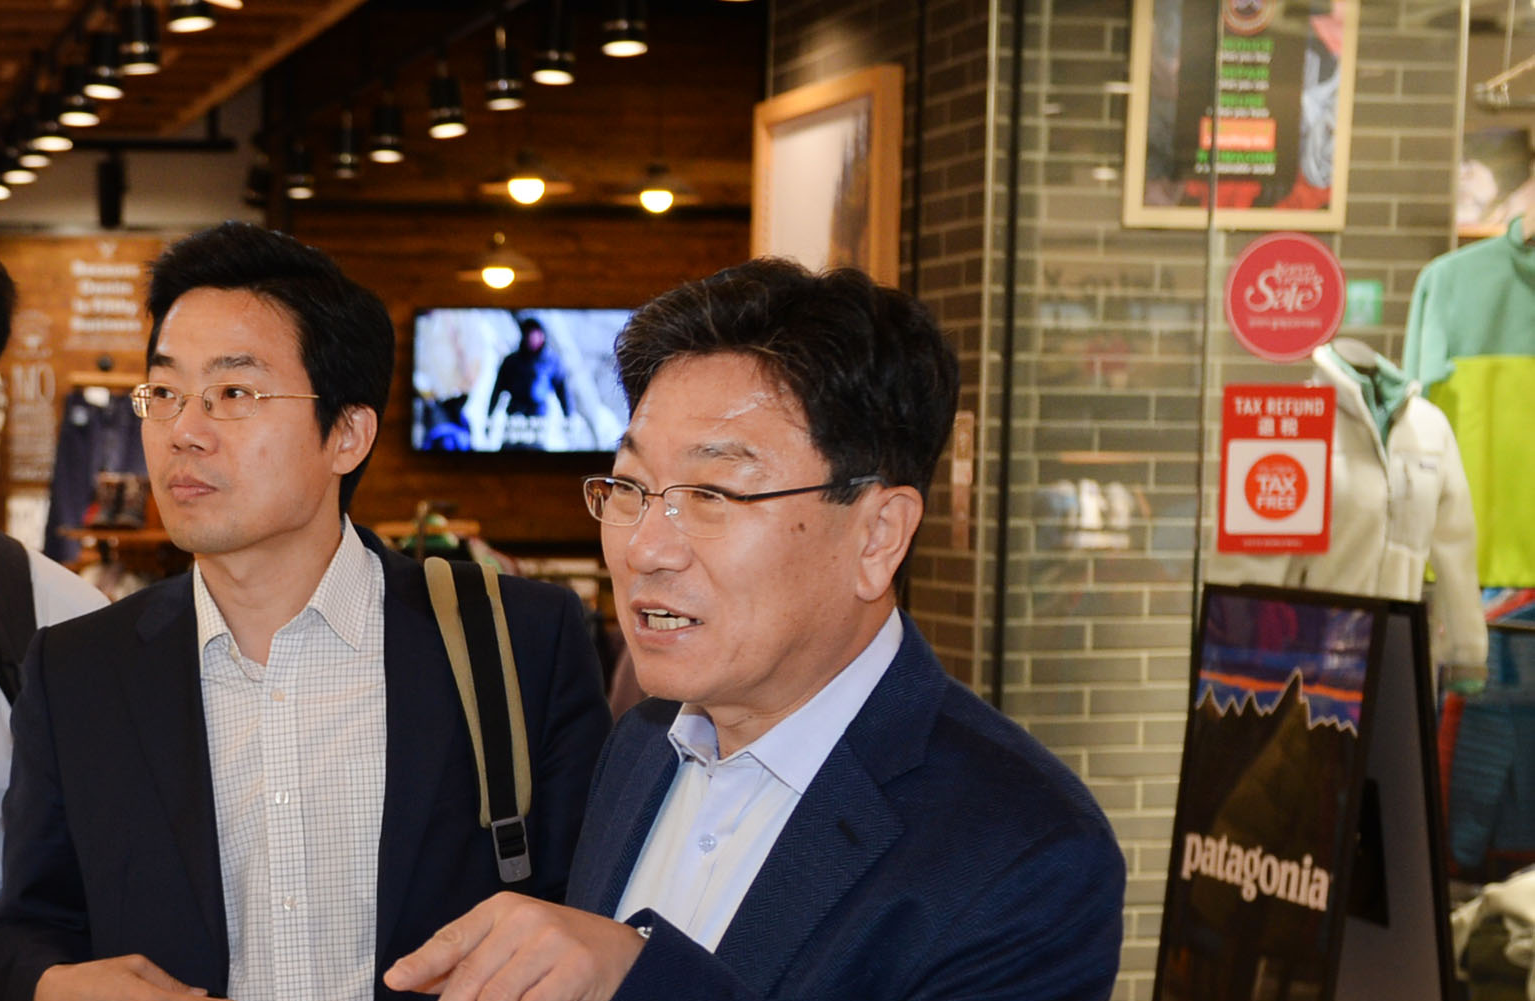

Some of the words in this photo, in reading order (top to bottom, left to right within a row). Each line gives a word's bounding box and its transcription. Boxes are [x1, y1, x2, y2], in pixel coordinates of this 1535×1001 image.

[1245, 268, 1324, 312] Sale
[1235, 396, 1262, 416] TAX
[1267, 397, 1326, 417] REFUND
[1255, 471, 1298, 496] TAX
[1255, 495, 1297, 511] FREE
[1180, 832, 1330, 912] patagonia
